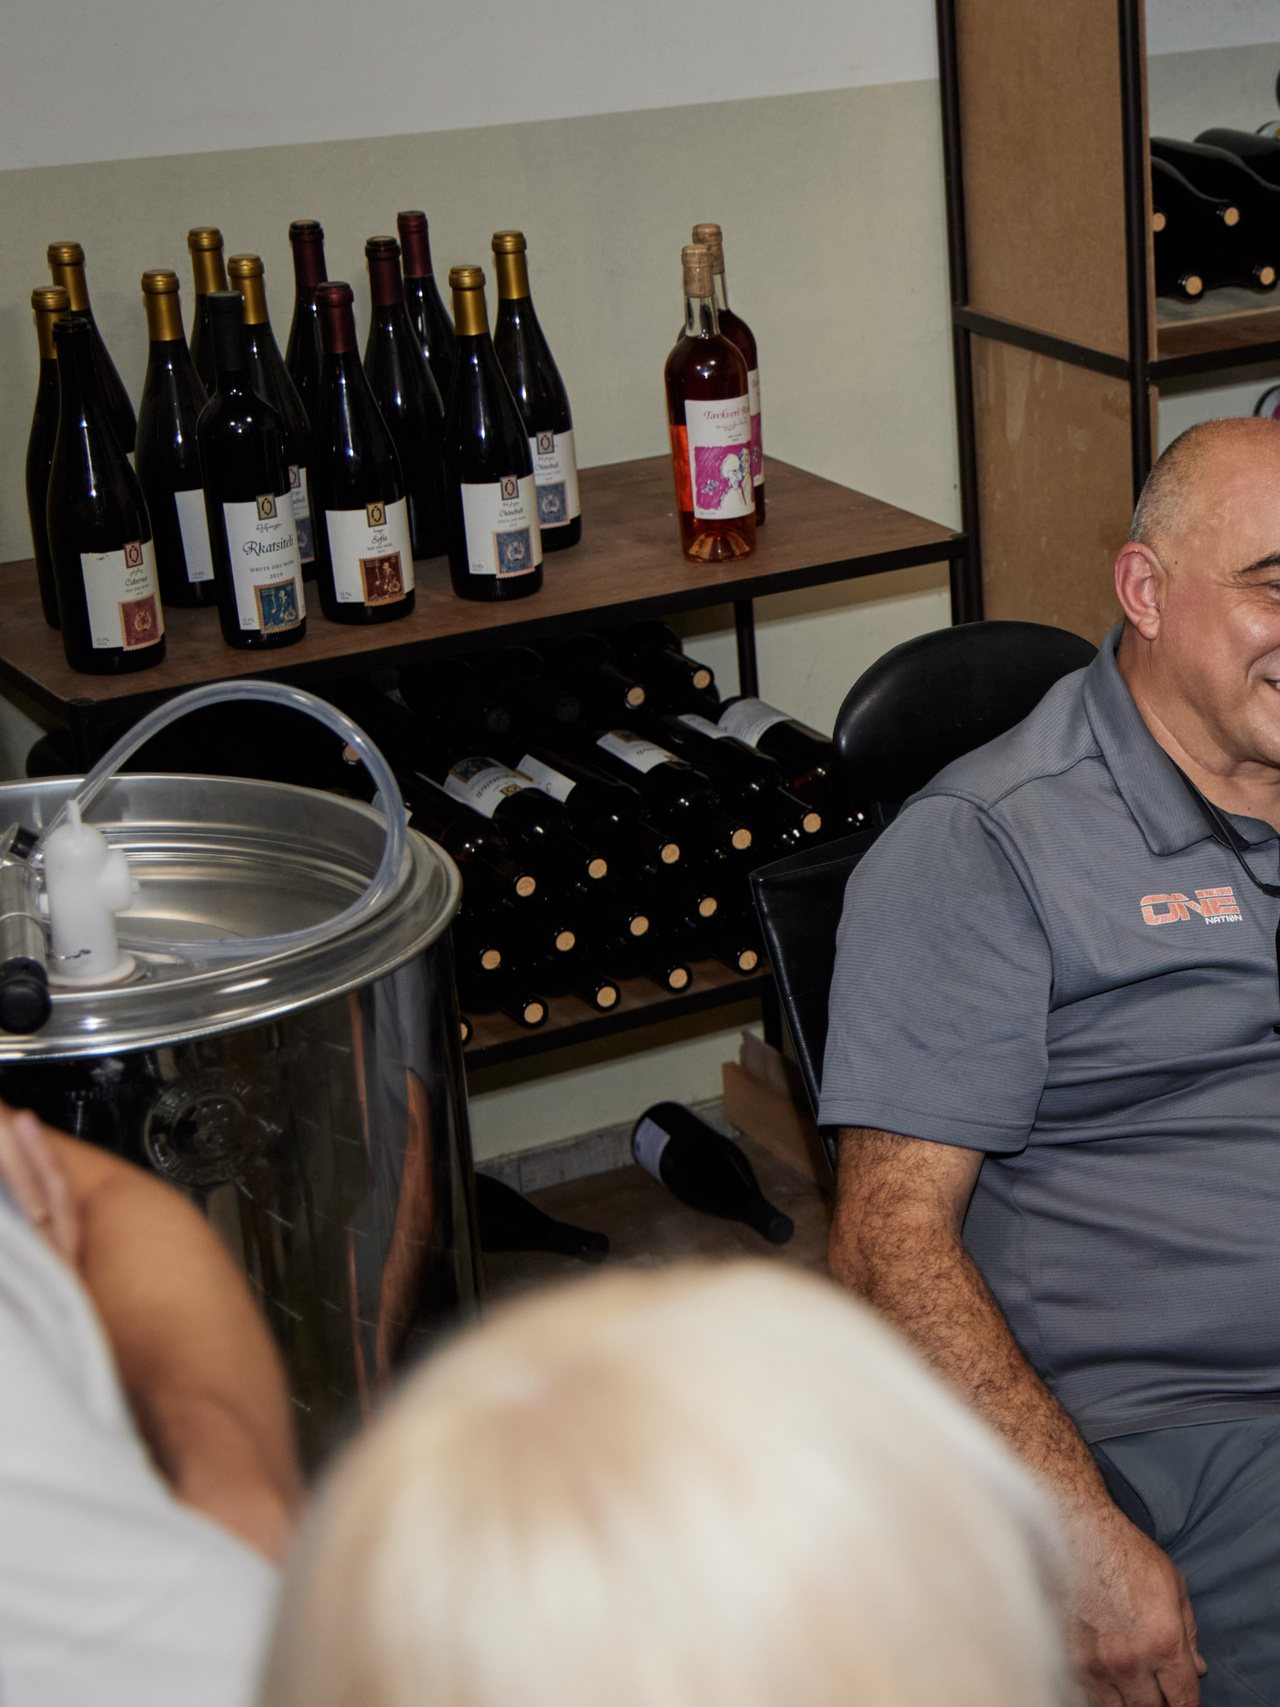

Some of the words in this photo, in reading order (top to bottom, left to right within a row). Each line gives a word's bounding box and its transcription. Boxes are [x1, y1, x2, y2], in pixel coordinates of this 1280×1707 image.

[703, 408, 740, 420] Tavkveri
[242, 533, 294, 556] Rkatsiteli
[371, 533, 388, 545] Sofia
[1140, 886, 1240, 925] ONE
[1205, 914, 1243, 925] NATION
